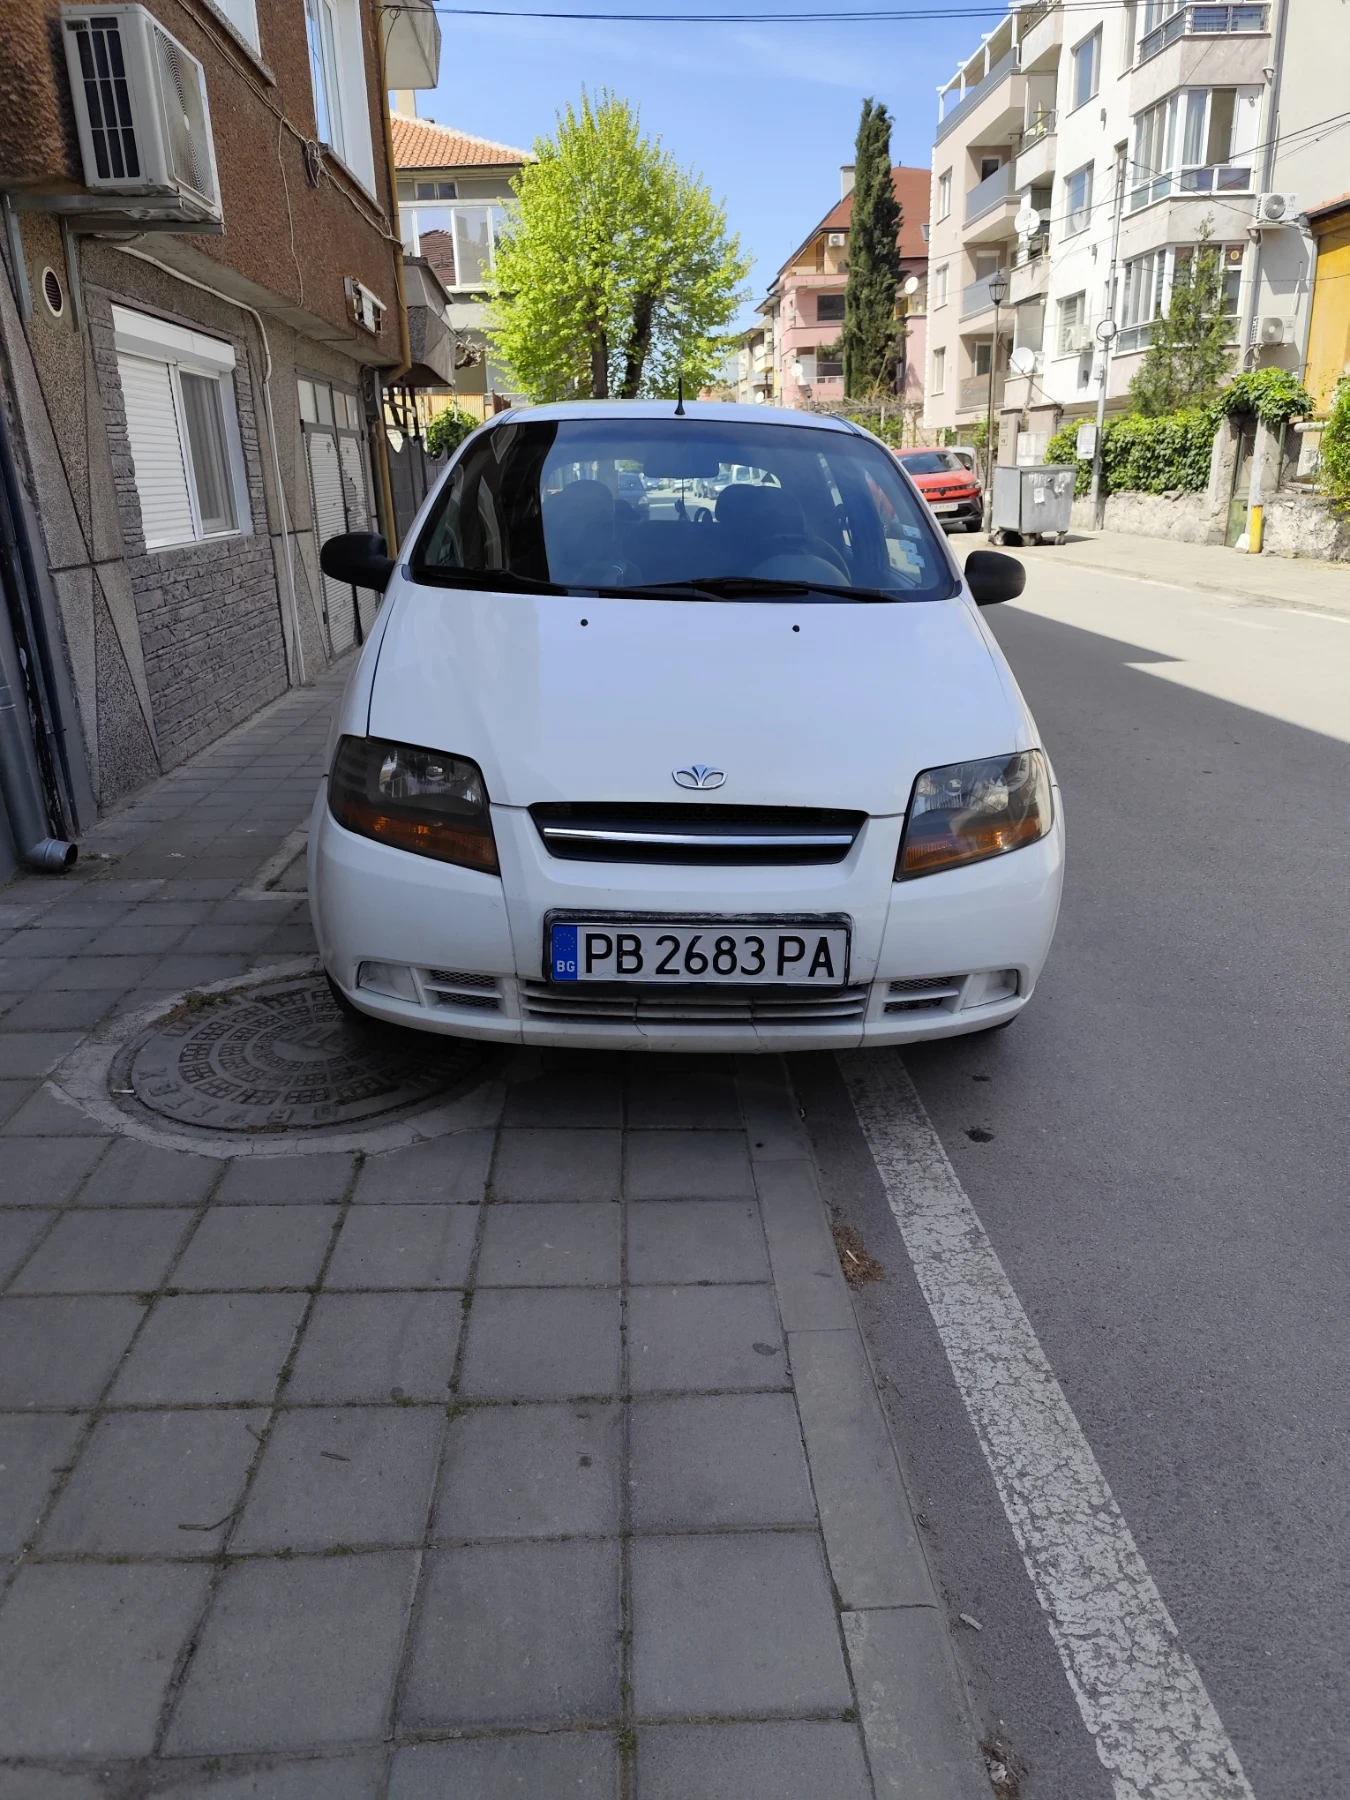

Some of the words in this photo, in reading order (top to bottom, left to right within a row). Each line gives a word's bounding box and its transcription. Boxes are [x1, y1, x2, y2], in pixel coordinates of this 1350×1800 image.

[556, 960, 576, 973] BG
[585, 933, 644, 974] PB
[655, 934, 766, 976] 2683
[777, 935, 835, 978] PA
